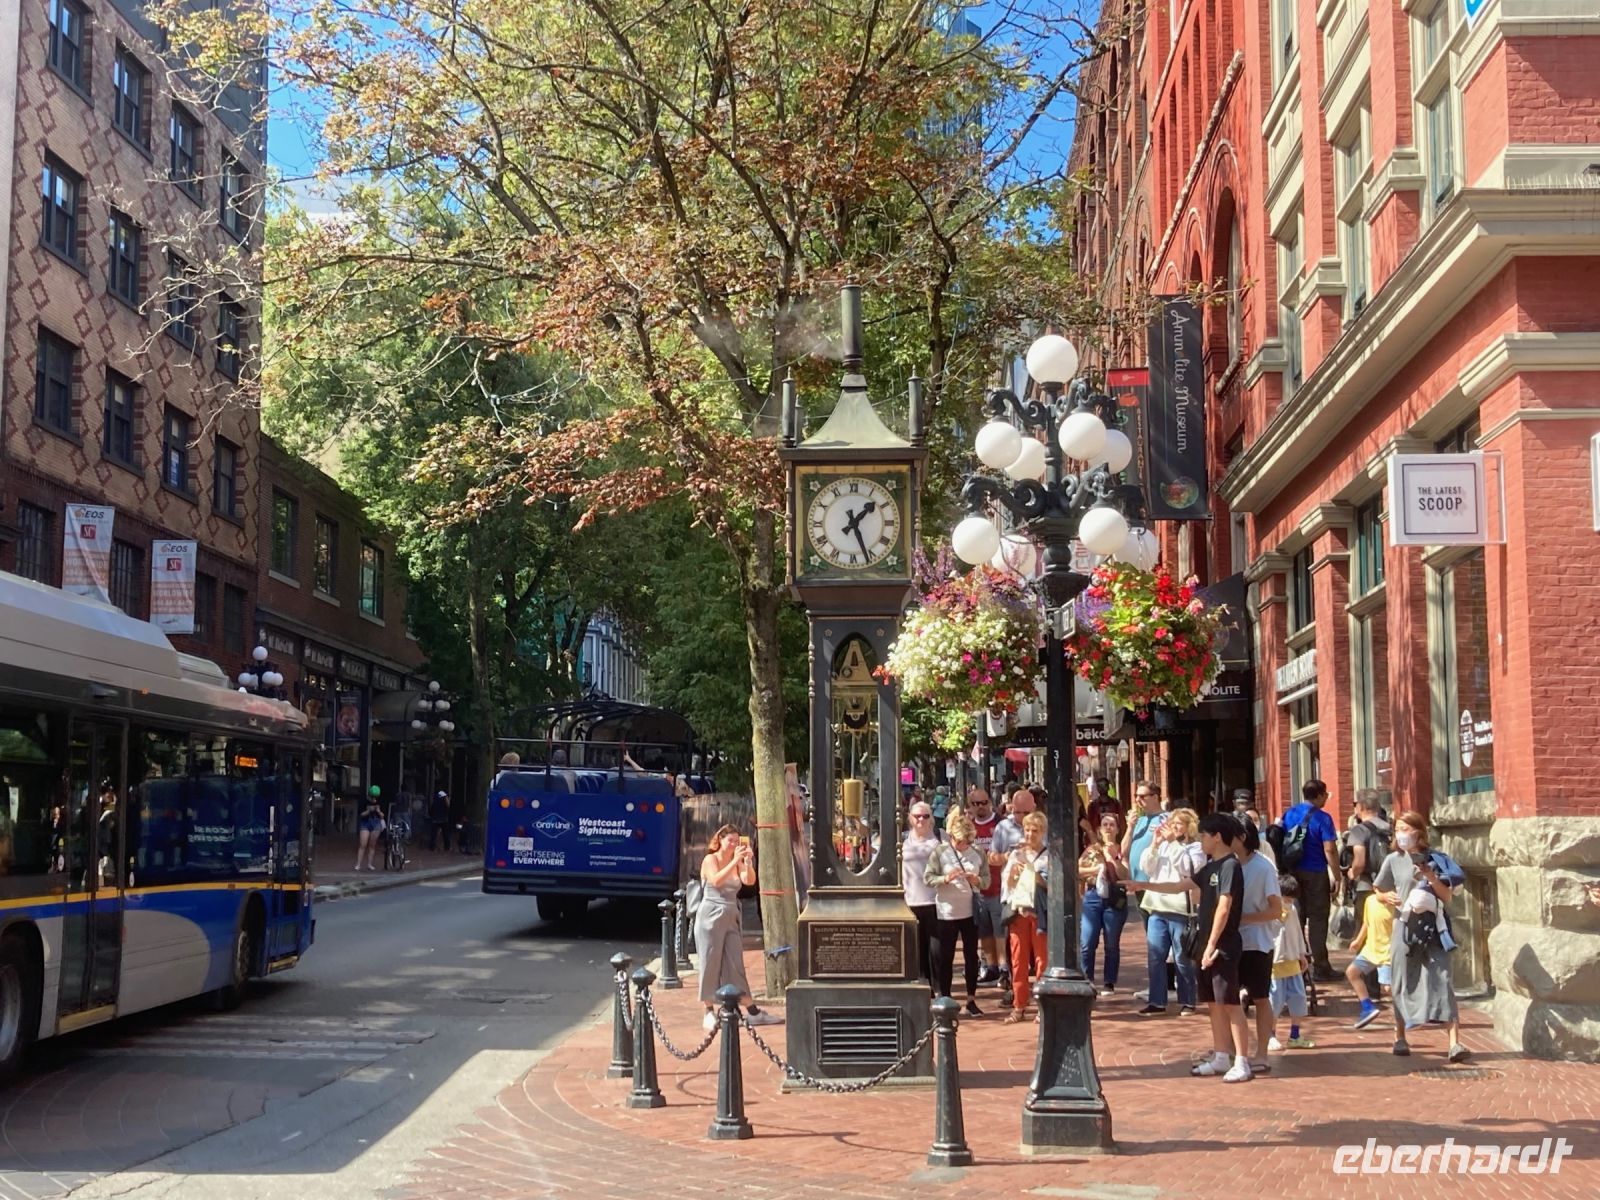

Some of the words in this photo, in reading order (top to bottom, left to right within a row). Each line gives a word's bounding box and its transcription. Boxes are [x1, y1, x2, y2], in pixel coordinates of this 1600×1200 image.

[1175, 386, 1189, 454] Museum
[1418, 486, 1432, 495] THE
[1435, 486, 1462, 495] LATEST
[1418, 497, 1463, 511] SCOOP
[579, 817, 625, 827] Westcoast
[579, 826, 632, 838] Sightseeing
[514, 850, 565, 858] SIGHTSEEING
[514, 857, 565, 866] EVERYWHERE
